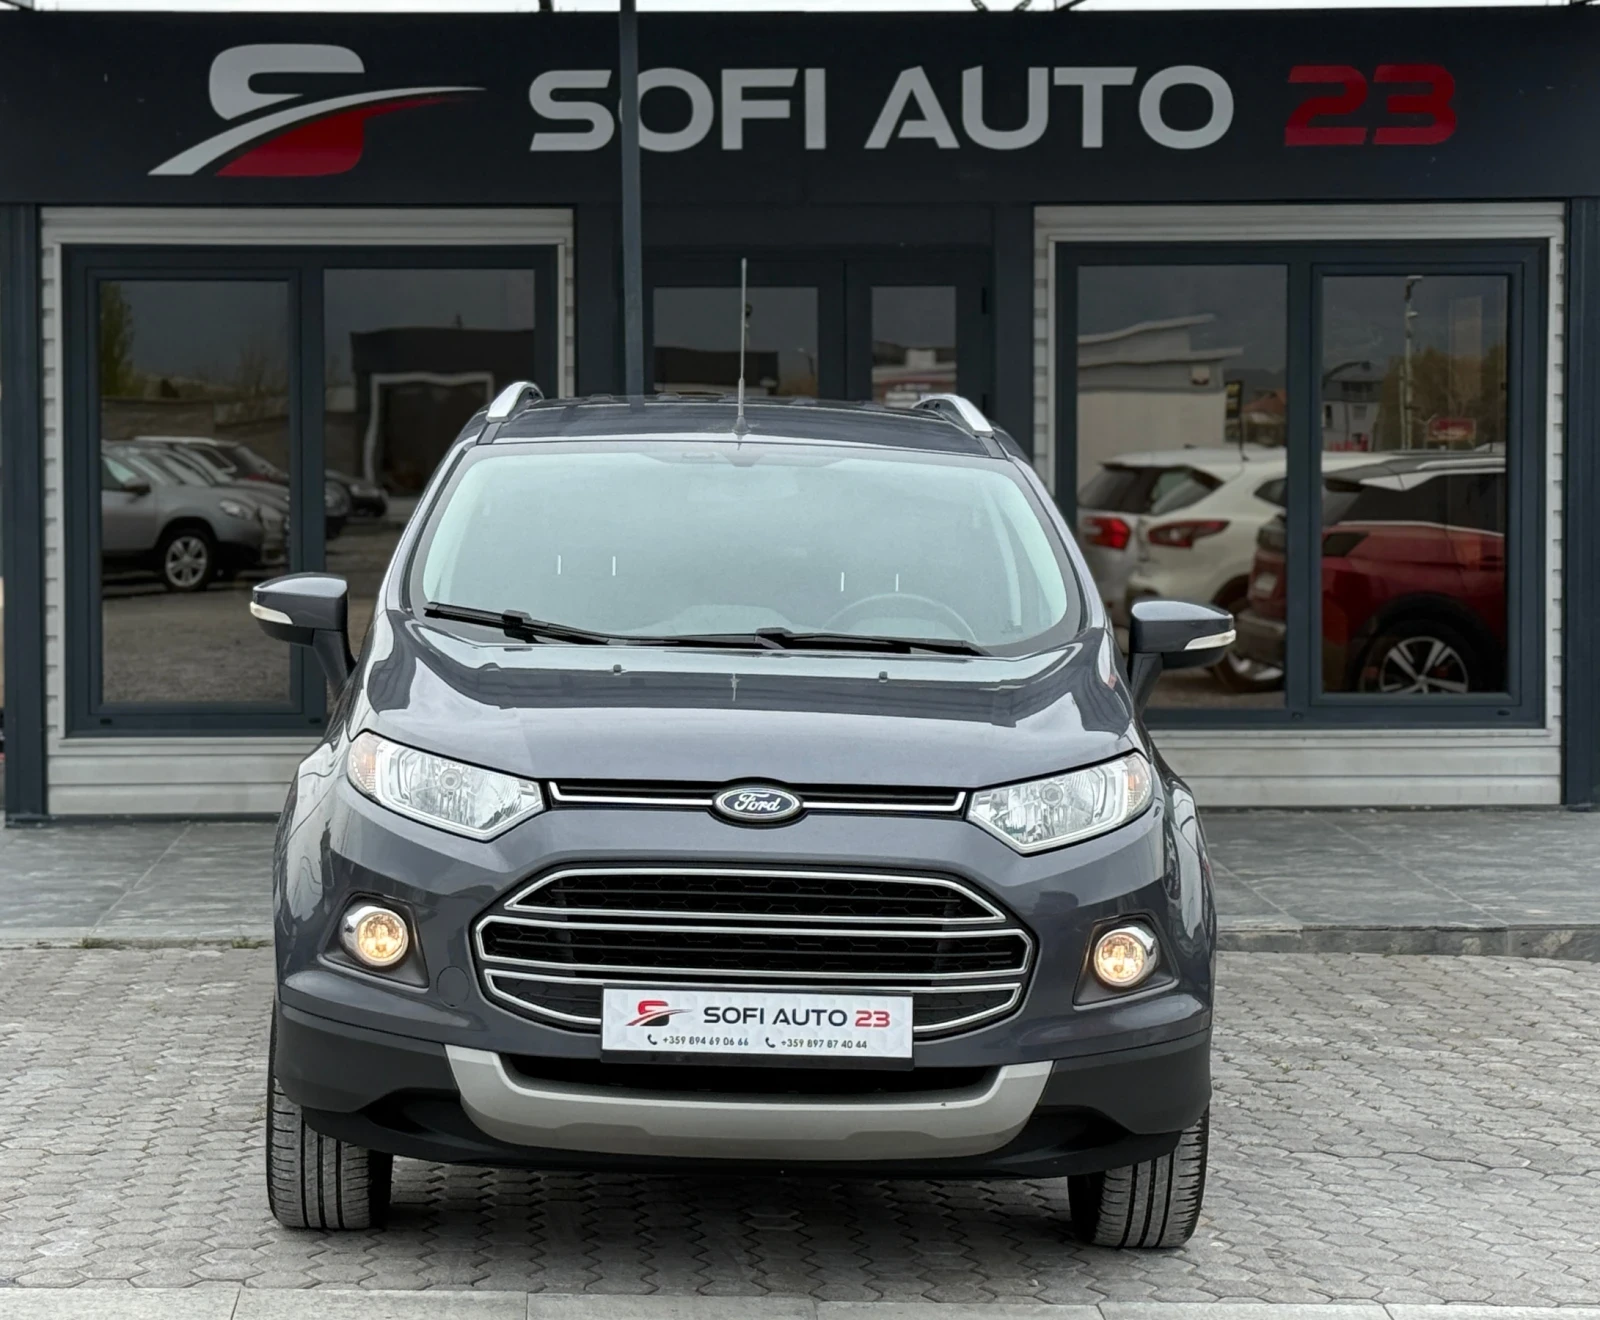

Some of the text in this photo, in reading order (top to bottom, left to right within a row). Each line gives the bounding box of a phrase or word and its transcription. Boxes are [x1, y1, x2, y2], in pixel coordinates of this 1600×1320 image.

[529, 64, 1457, 152] SOFI AUTO 23
[734, 792, 781, 811] Ford
[703, 1006, 891, 1028] SOFI AUTO 23
[662, 1035, 749, 1046] +359 894 69 06 66
[781, 1038, 868, 1049] +359 897 87 40 44
